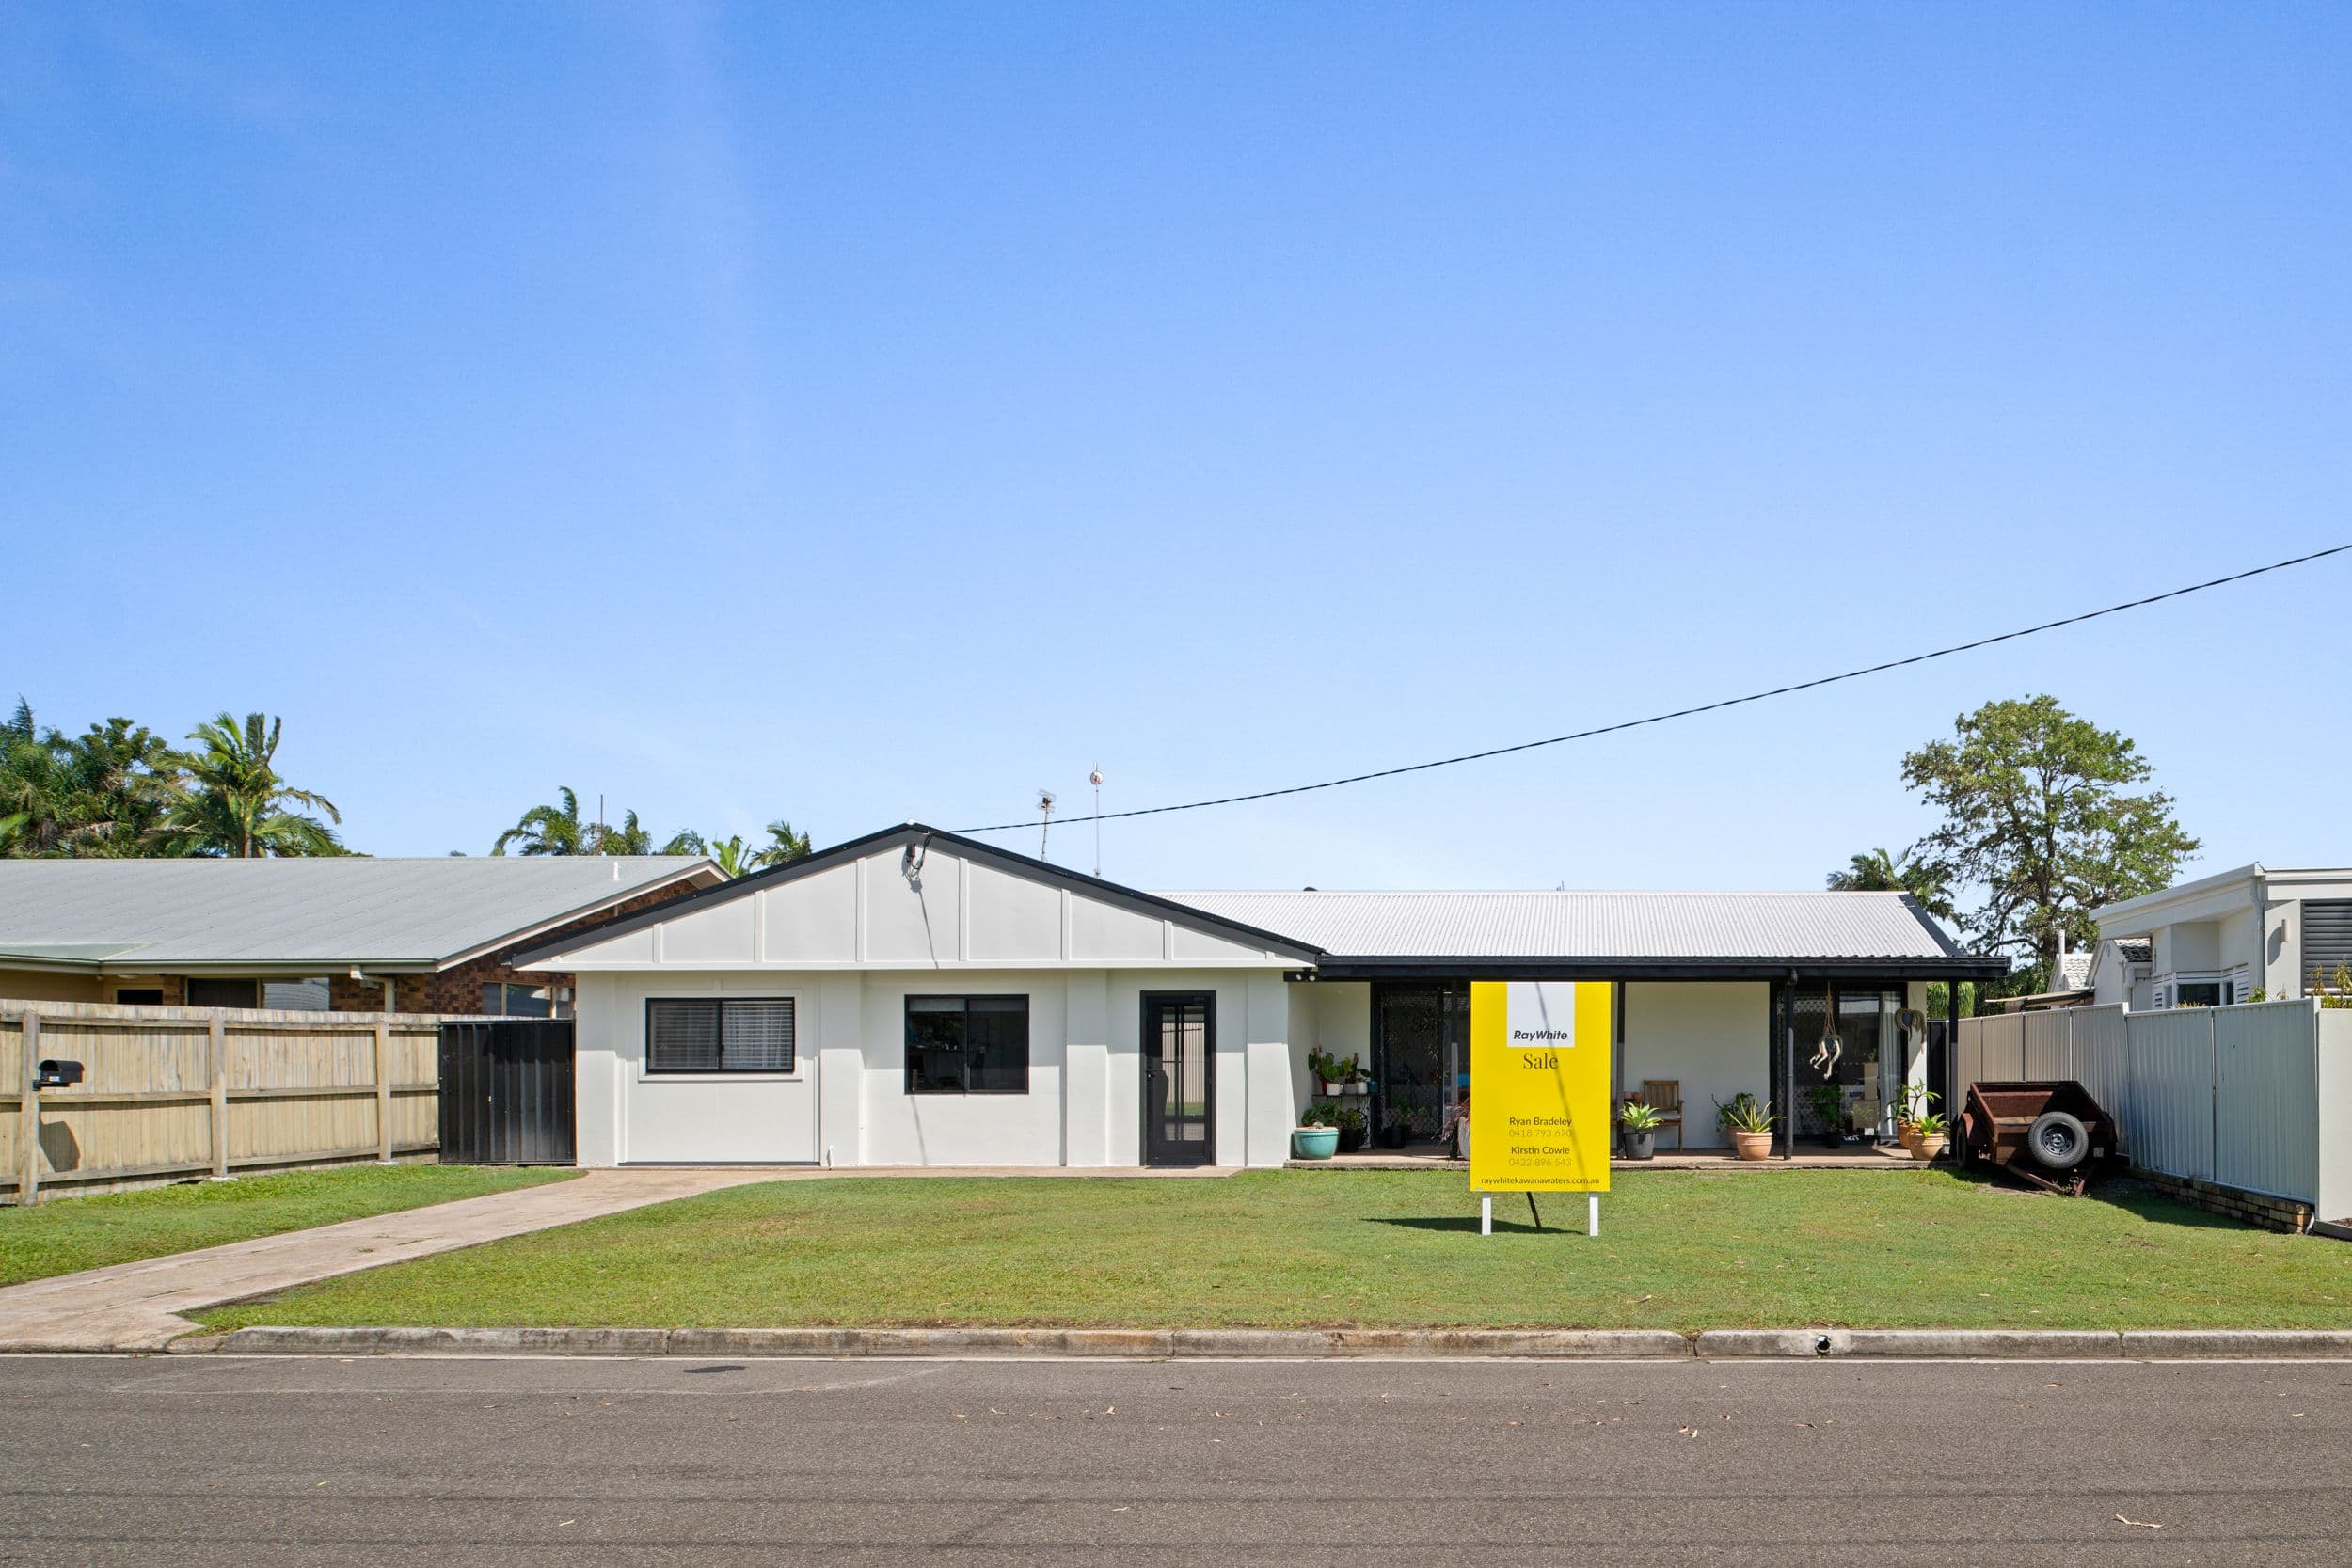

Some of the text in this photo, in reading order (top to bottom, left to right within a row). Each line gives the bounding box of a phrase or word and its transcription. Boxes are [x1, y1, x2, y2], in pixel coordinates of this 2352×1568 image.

[1523, 1053, 1558, 1069] Sale
[1510, 1117, 1572, 1126] Ryan Bradeley
[1511, 1146, 1570, 1155] Kirstin Cowie
[1509, 1158, 1572, 1166] 0422 896 543
[1481, 1177, 1599, 1185] raywhitekawanawaters.com.au
